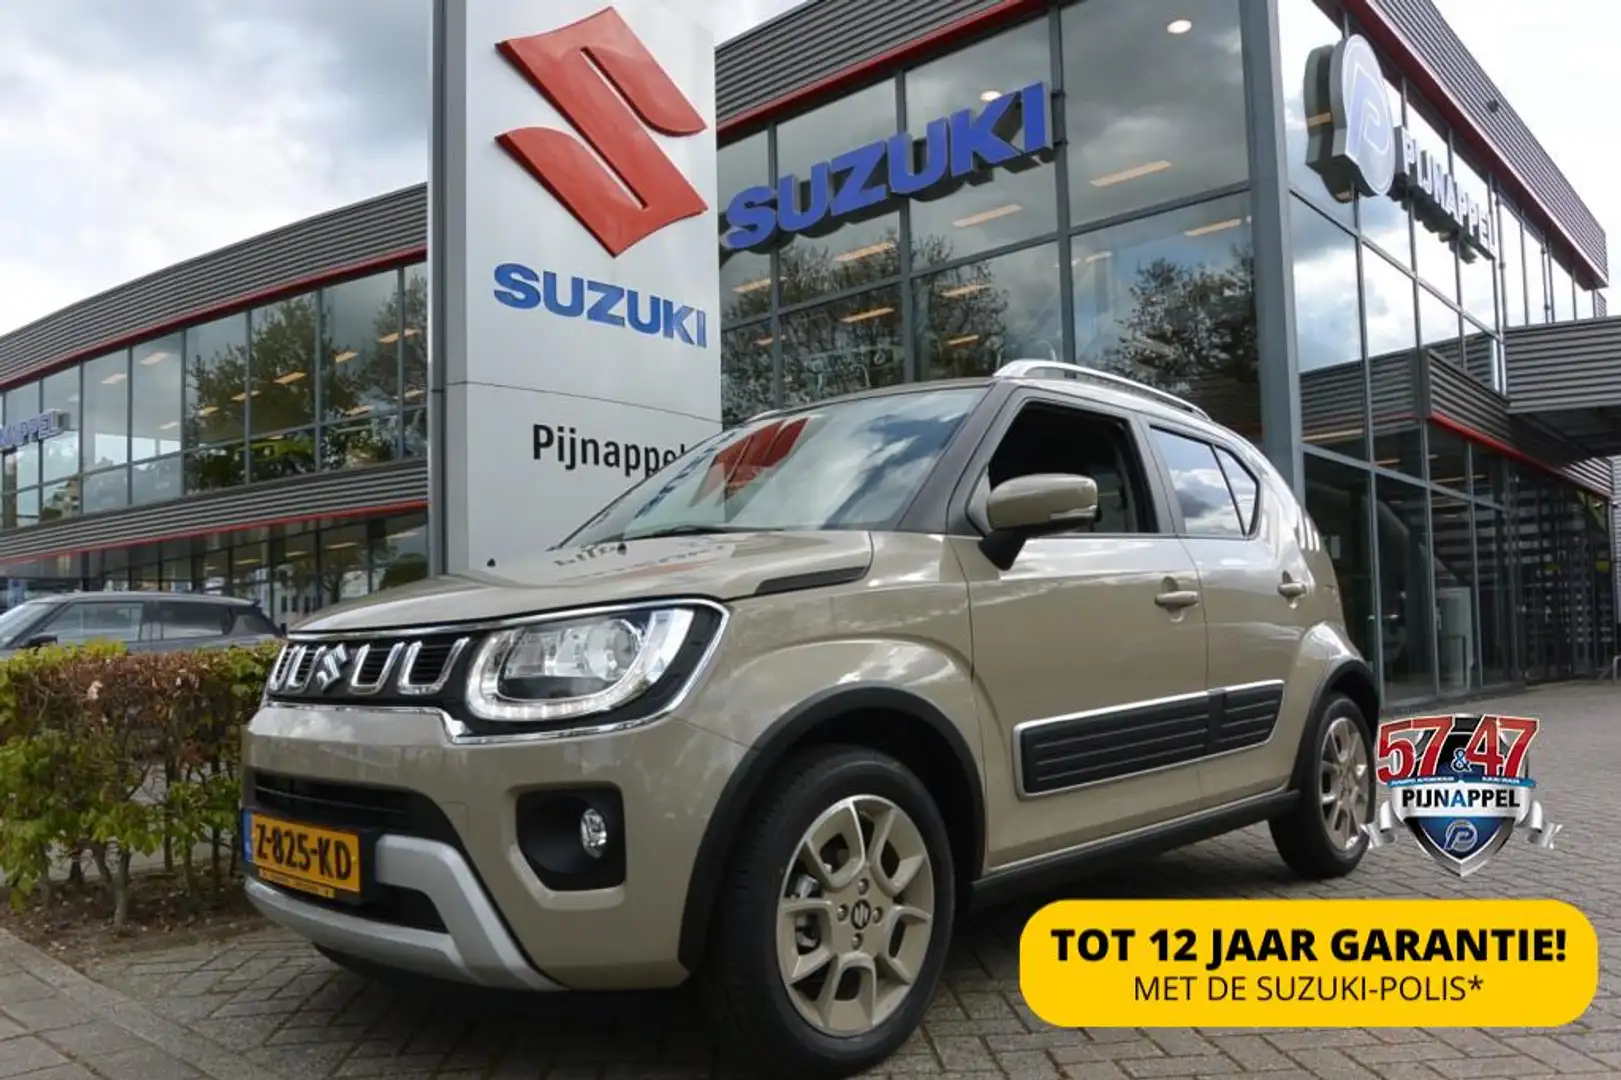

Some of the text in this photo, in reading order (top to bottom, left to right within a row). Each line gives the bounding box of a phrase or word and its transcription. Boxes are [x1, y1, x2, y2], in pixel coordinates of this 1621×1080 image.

[722, 81, 1053, 250] SUZUKI
[493, 262, 708, 348] SUZUKI
[532, 423, 686, 479] Pijnappe
[255, 823, 352, 881] Z-825-KD
